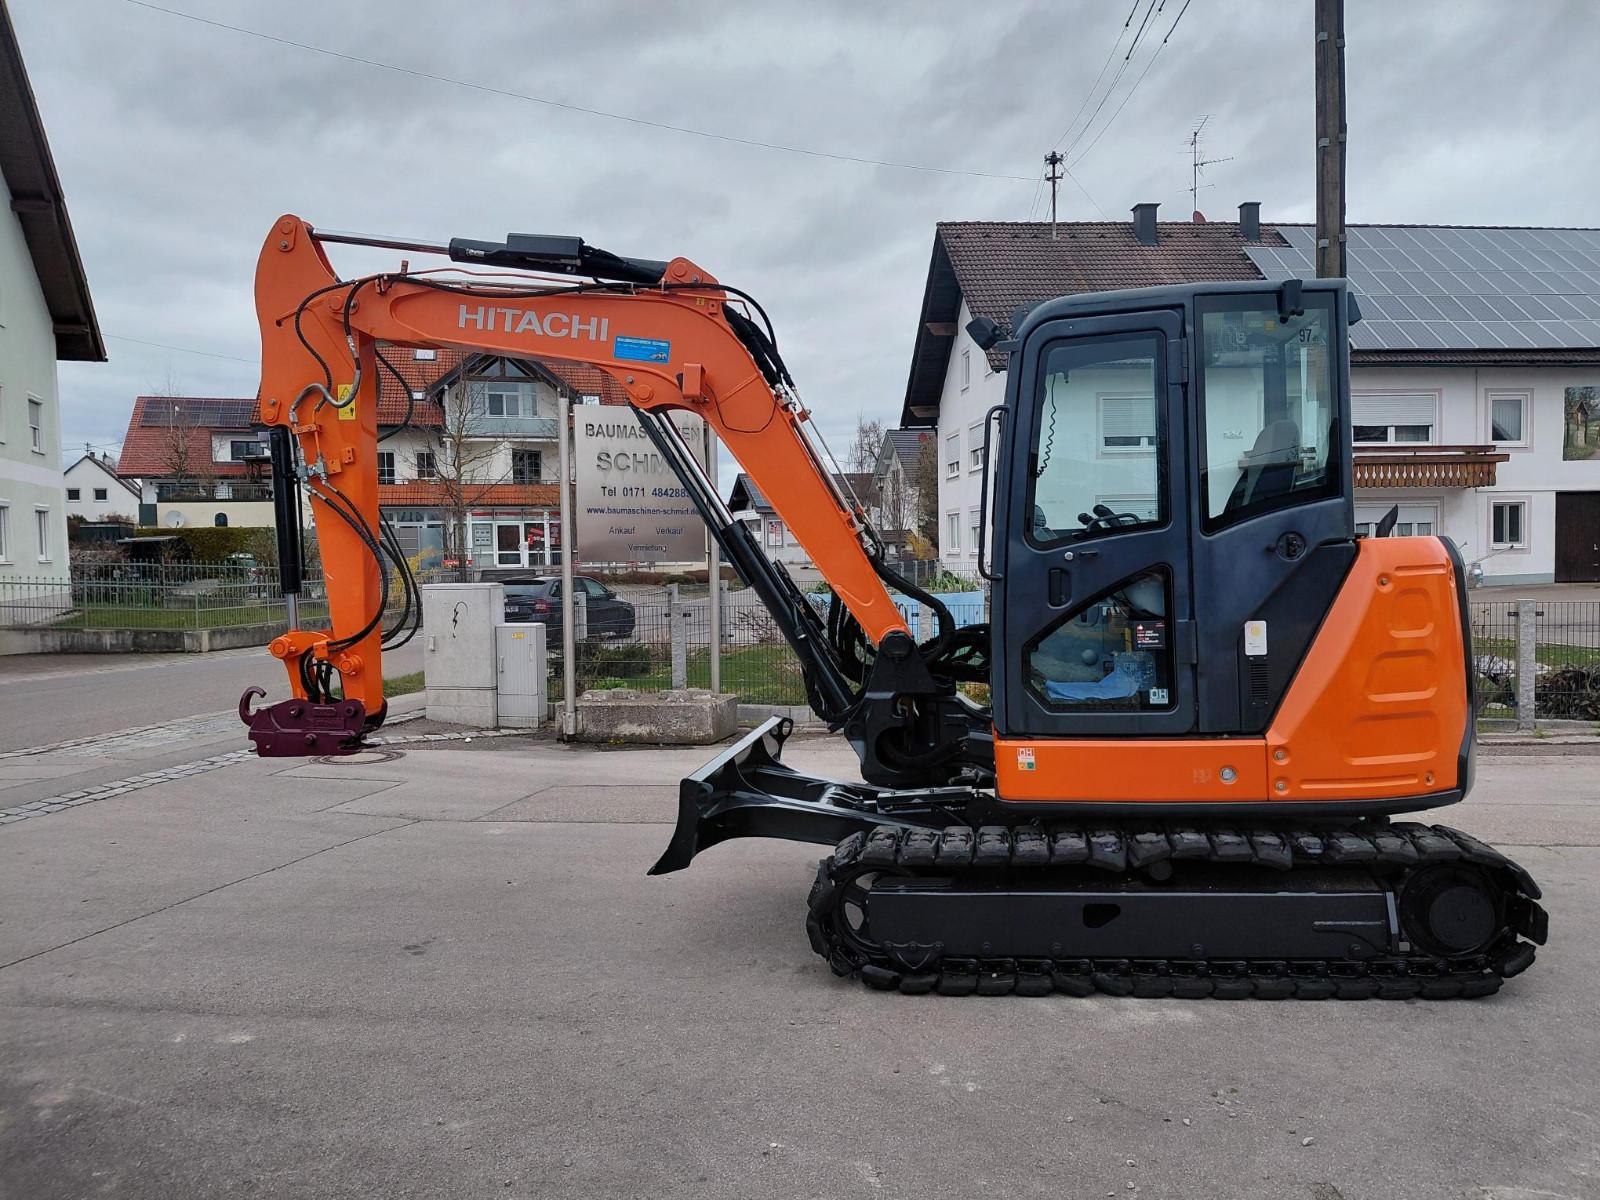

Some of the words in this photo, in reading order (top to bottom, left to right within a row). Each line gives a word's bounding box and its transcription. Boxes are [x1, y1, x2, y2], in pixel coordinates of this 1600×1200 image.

[458, 304, 609, 342] HITACHI
[1299, 328, 1312, 342] 97
[601, 486, 617, 497] Tel
[622, 487, 645, 497] 0171
[651, 487, 690, 498] 484288
[608, 526, 636, 535] Ankauf
[655, 526, 684, 535] Verkauf
